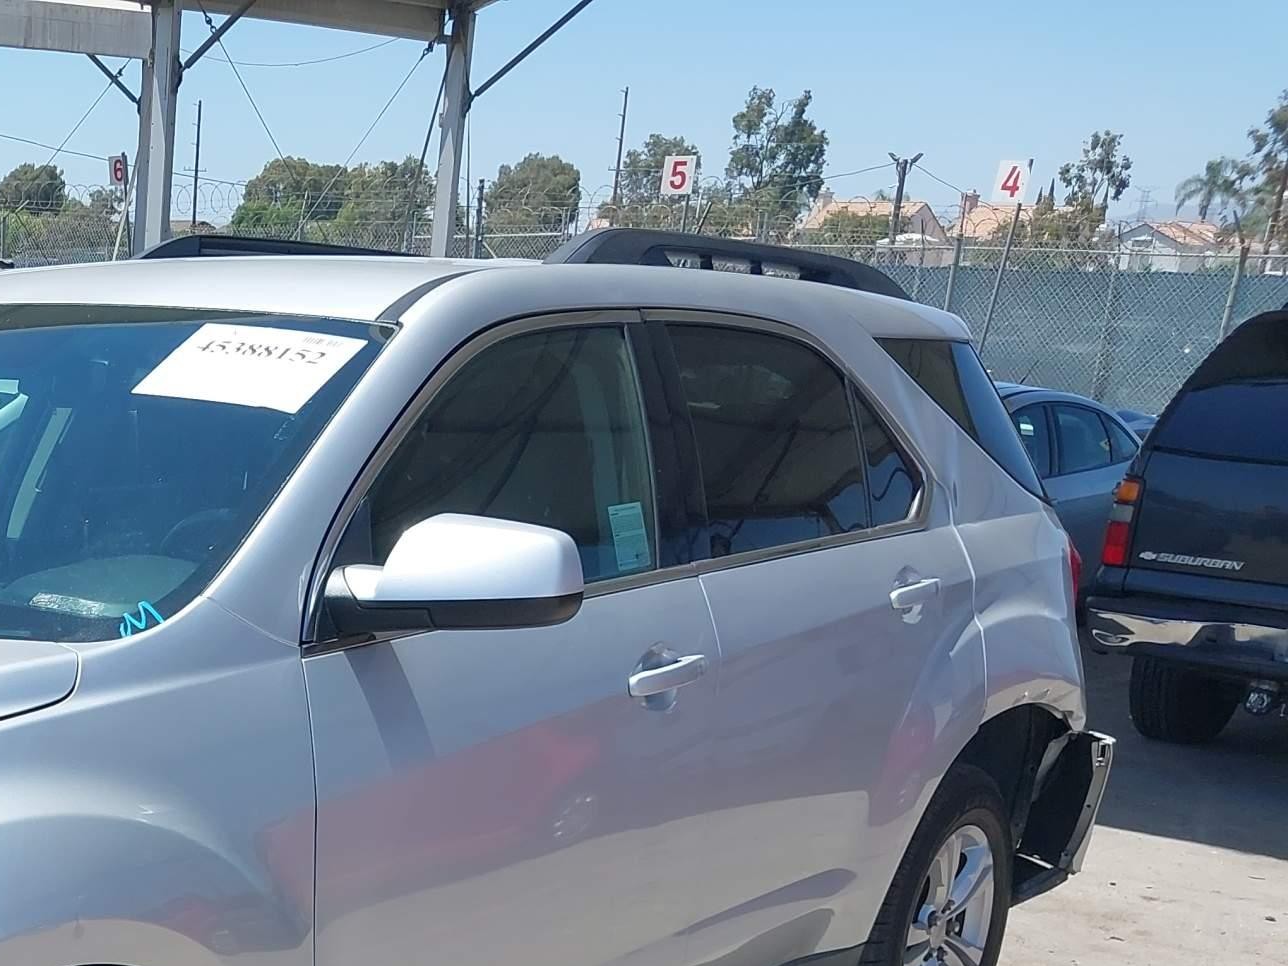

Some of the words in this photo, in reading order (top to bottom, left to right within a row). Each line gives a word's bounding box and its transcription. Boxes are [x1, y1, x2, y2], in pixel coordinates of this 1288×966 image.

[113, 159, 124, 182] 6
[669, 160, 688, 190] 5
[1000, 165, 1021, 197] 4
[196, 340, 327, 365] 45388152
[1156, 553, 1246, 571] SUBURBAN
